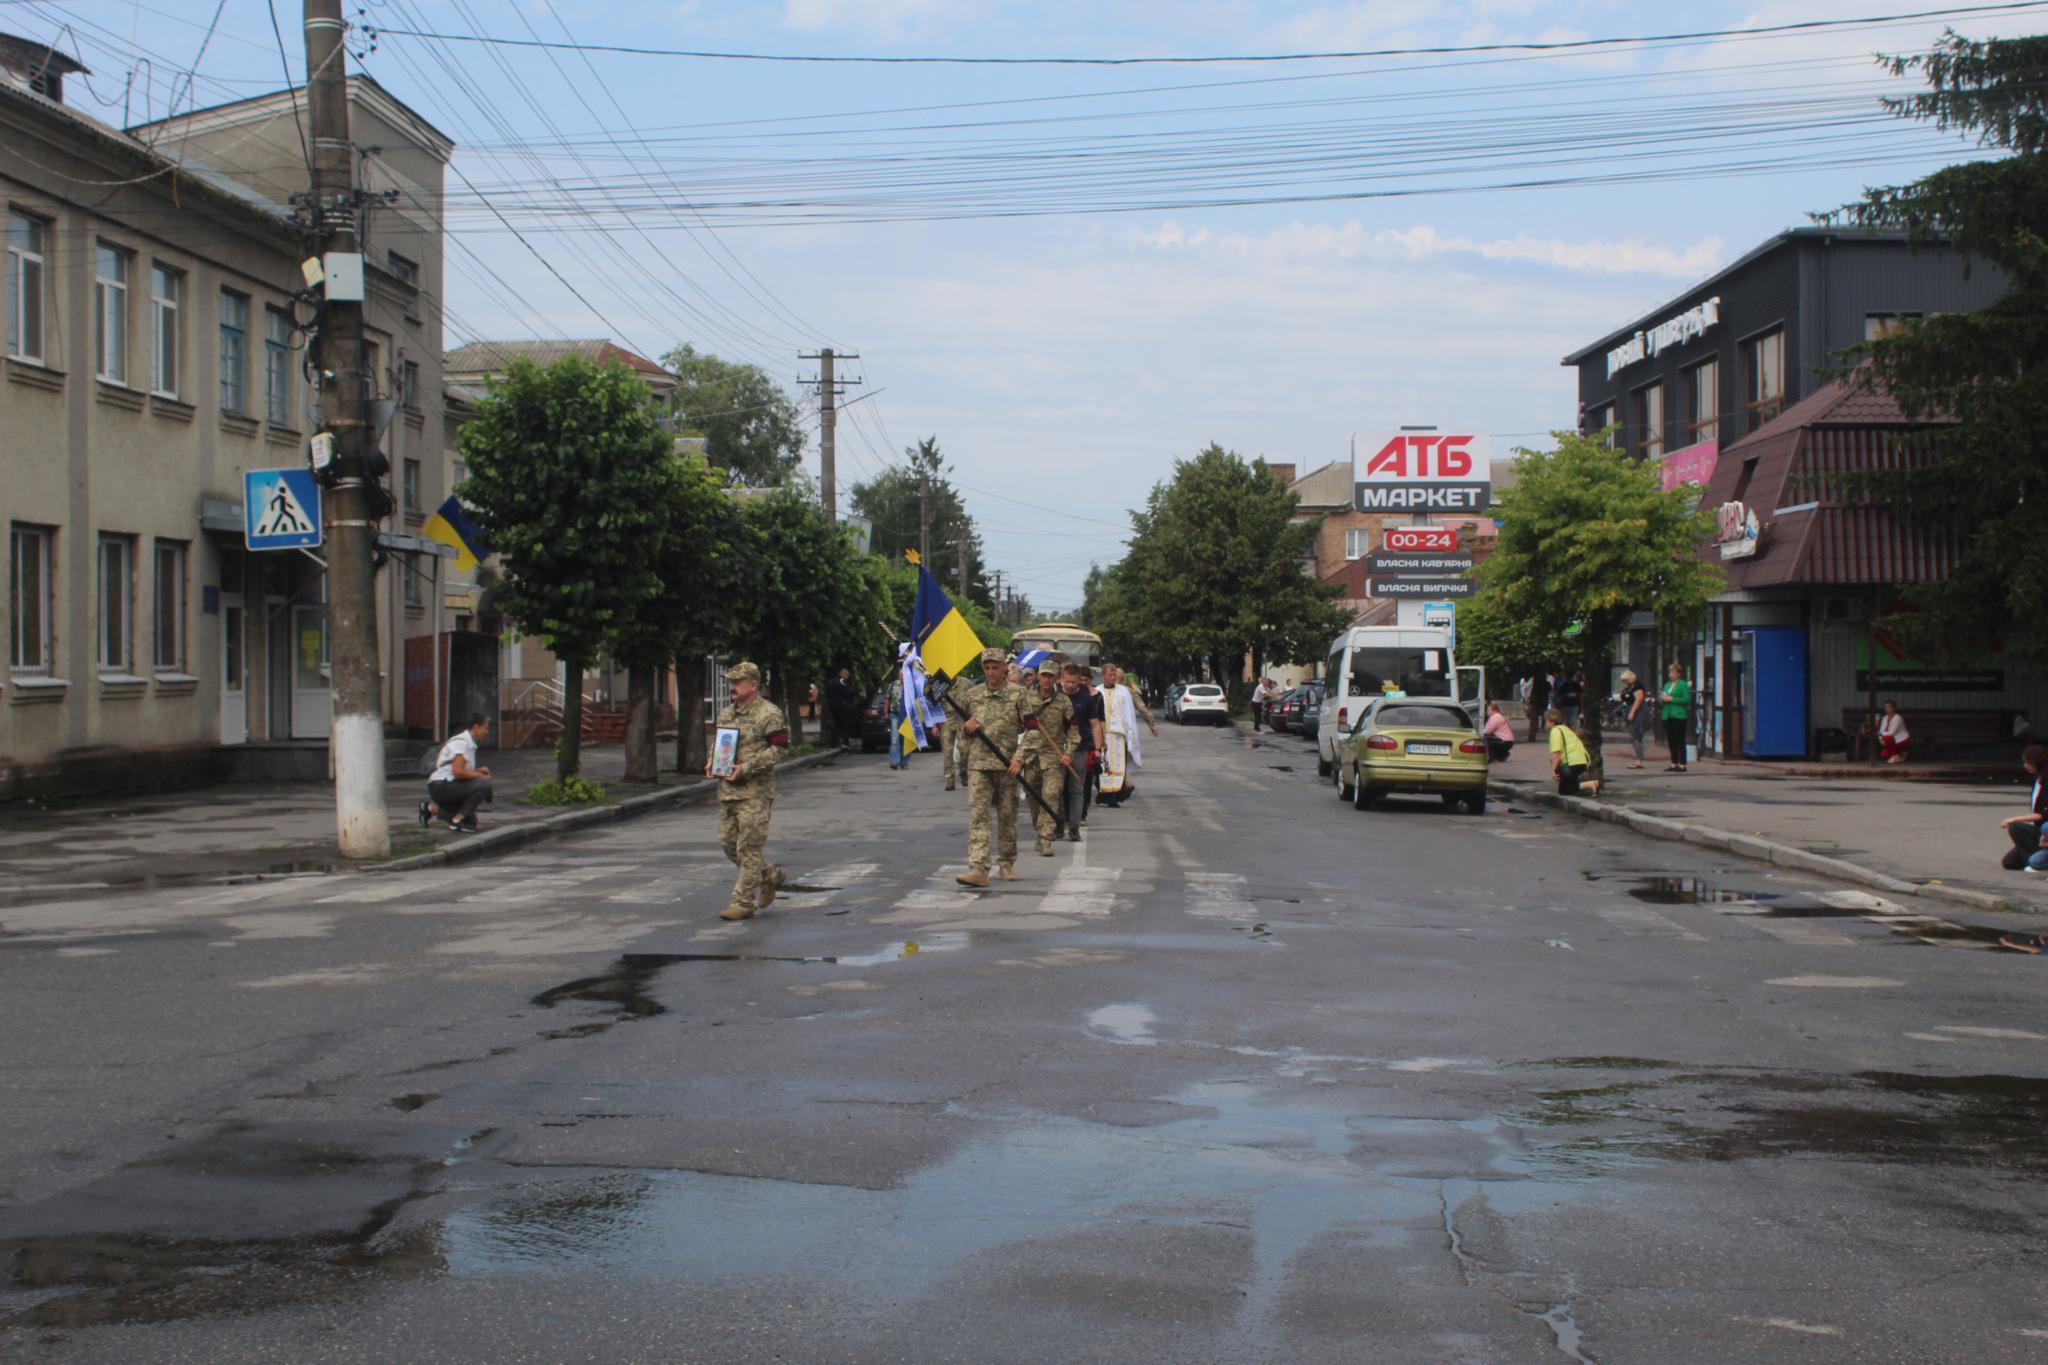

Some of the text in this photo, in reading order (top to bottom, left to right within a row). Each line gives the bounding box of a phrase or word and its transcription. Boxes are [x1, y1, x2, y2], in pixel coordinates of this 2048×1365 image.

[1368, 436, 1474, 476] АТБ
[1364, 488, 1481, 507] МАРКЕТ
[1392, 534, 1451, 546] 00-24
[1377, 560, 1419, 568] ВЛАСНА
[1378, 584, 1467, 592] ВЛАСНА ВИПІЧКА
